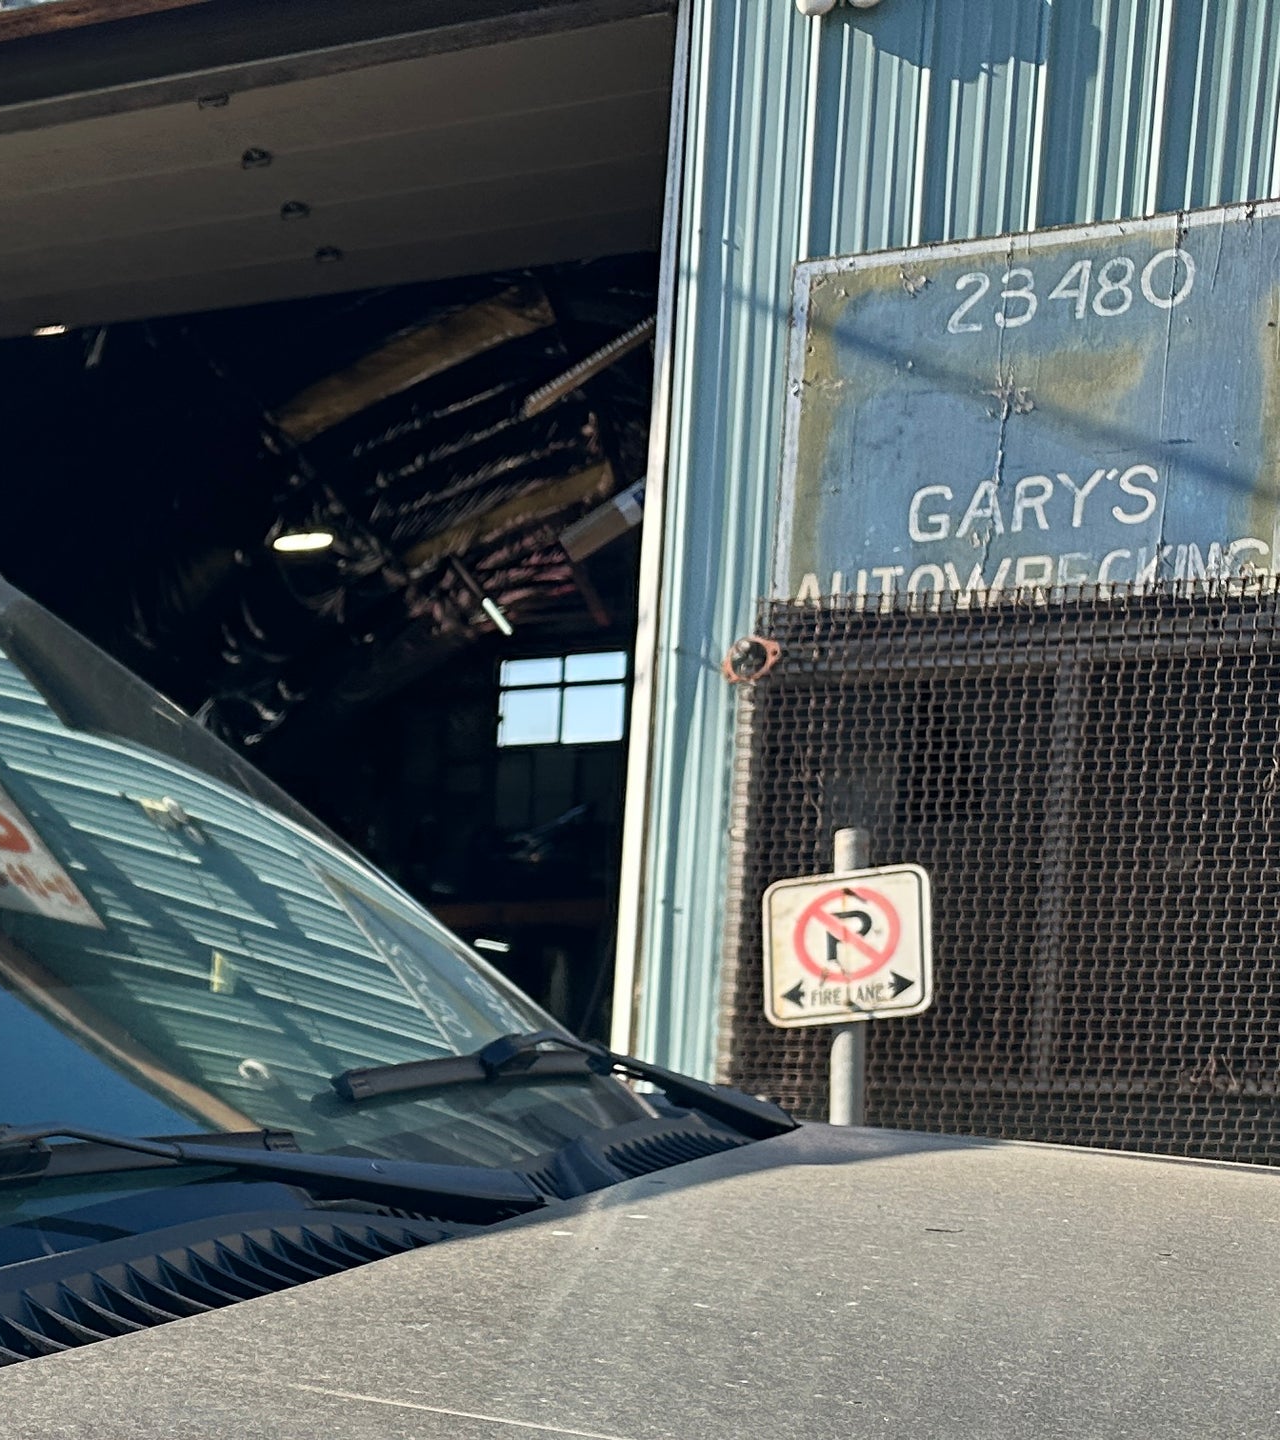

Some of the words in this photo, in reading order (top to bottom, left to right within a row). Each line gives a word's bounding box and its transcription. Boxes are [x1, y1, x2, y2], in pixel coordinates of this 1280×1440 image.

[947, 248, 1197, 334] 23480
[907, 464, 1160, 543] GARY'S
[810, 987, 842, 1006] FIRE
